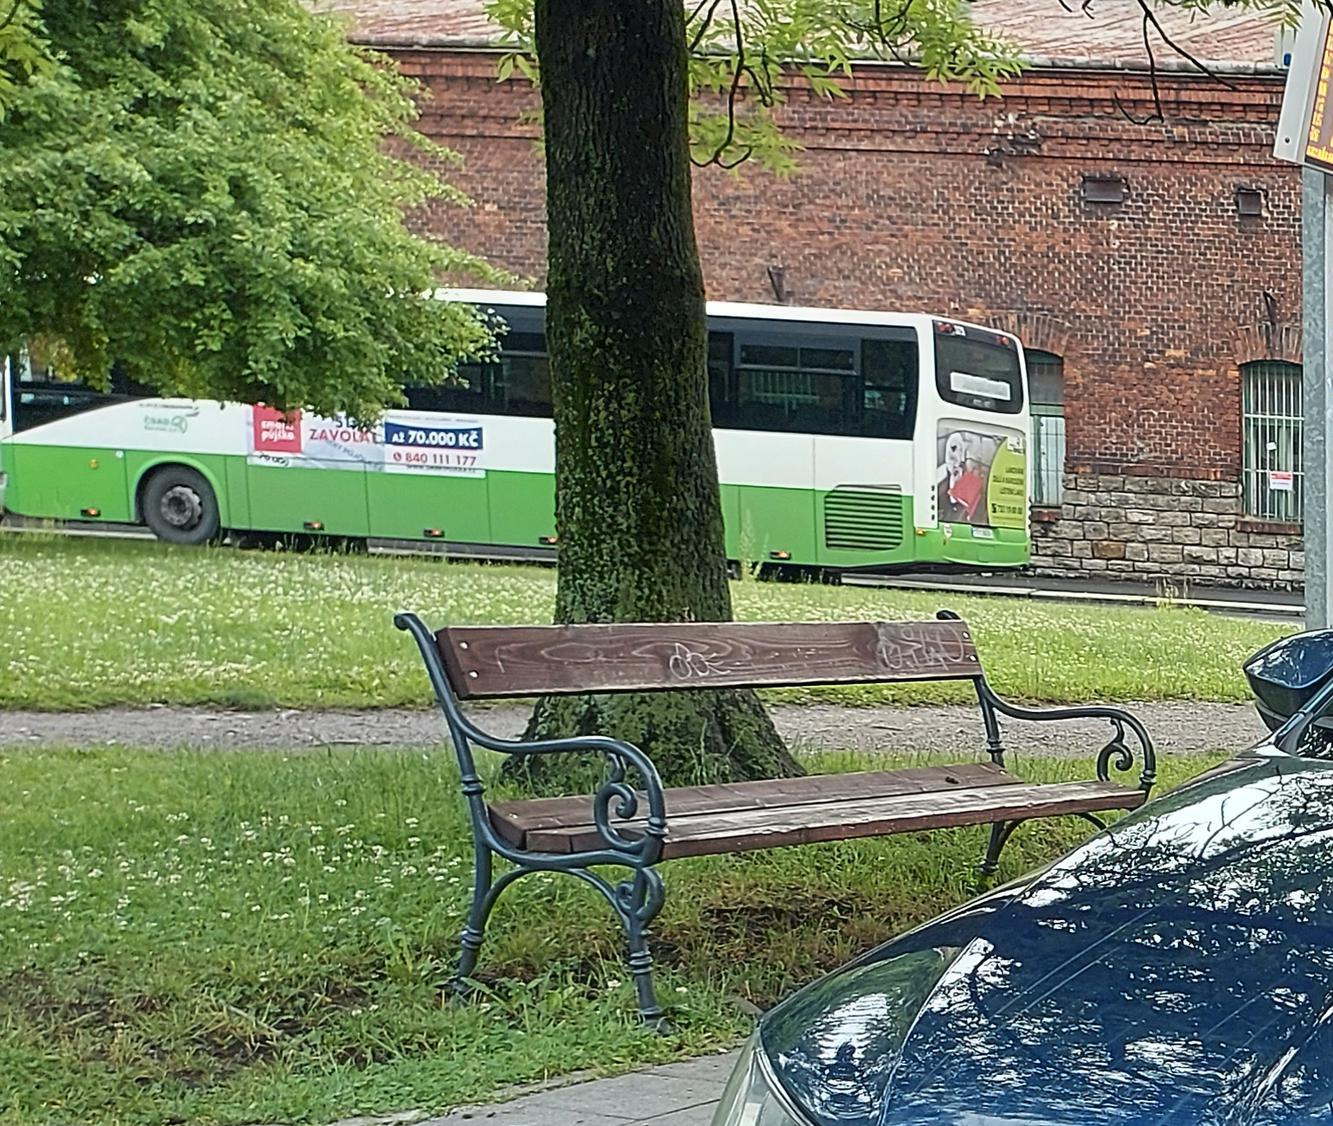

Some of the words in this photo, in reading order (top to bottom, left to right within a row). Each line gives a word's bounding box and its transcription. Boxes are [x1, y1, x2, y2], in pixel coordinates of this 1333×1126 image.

[408, 430, 456, 446] 70.000
[405, 452, 428, 464] 840
[433, 454, 449, 465] 111
[456, 455, 476, 466] 177
